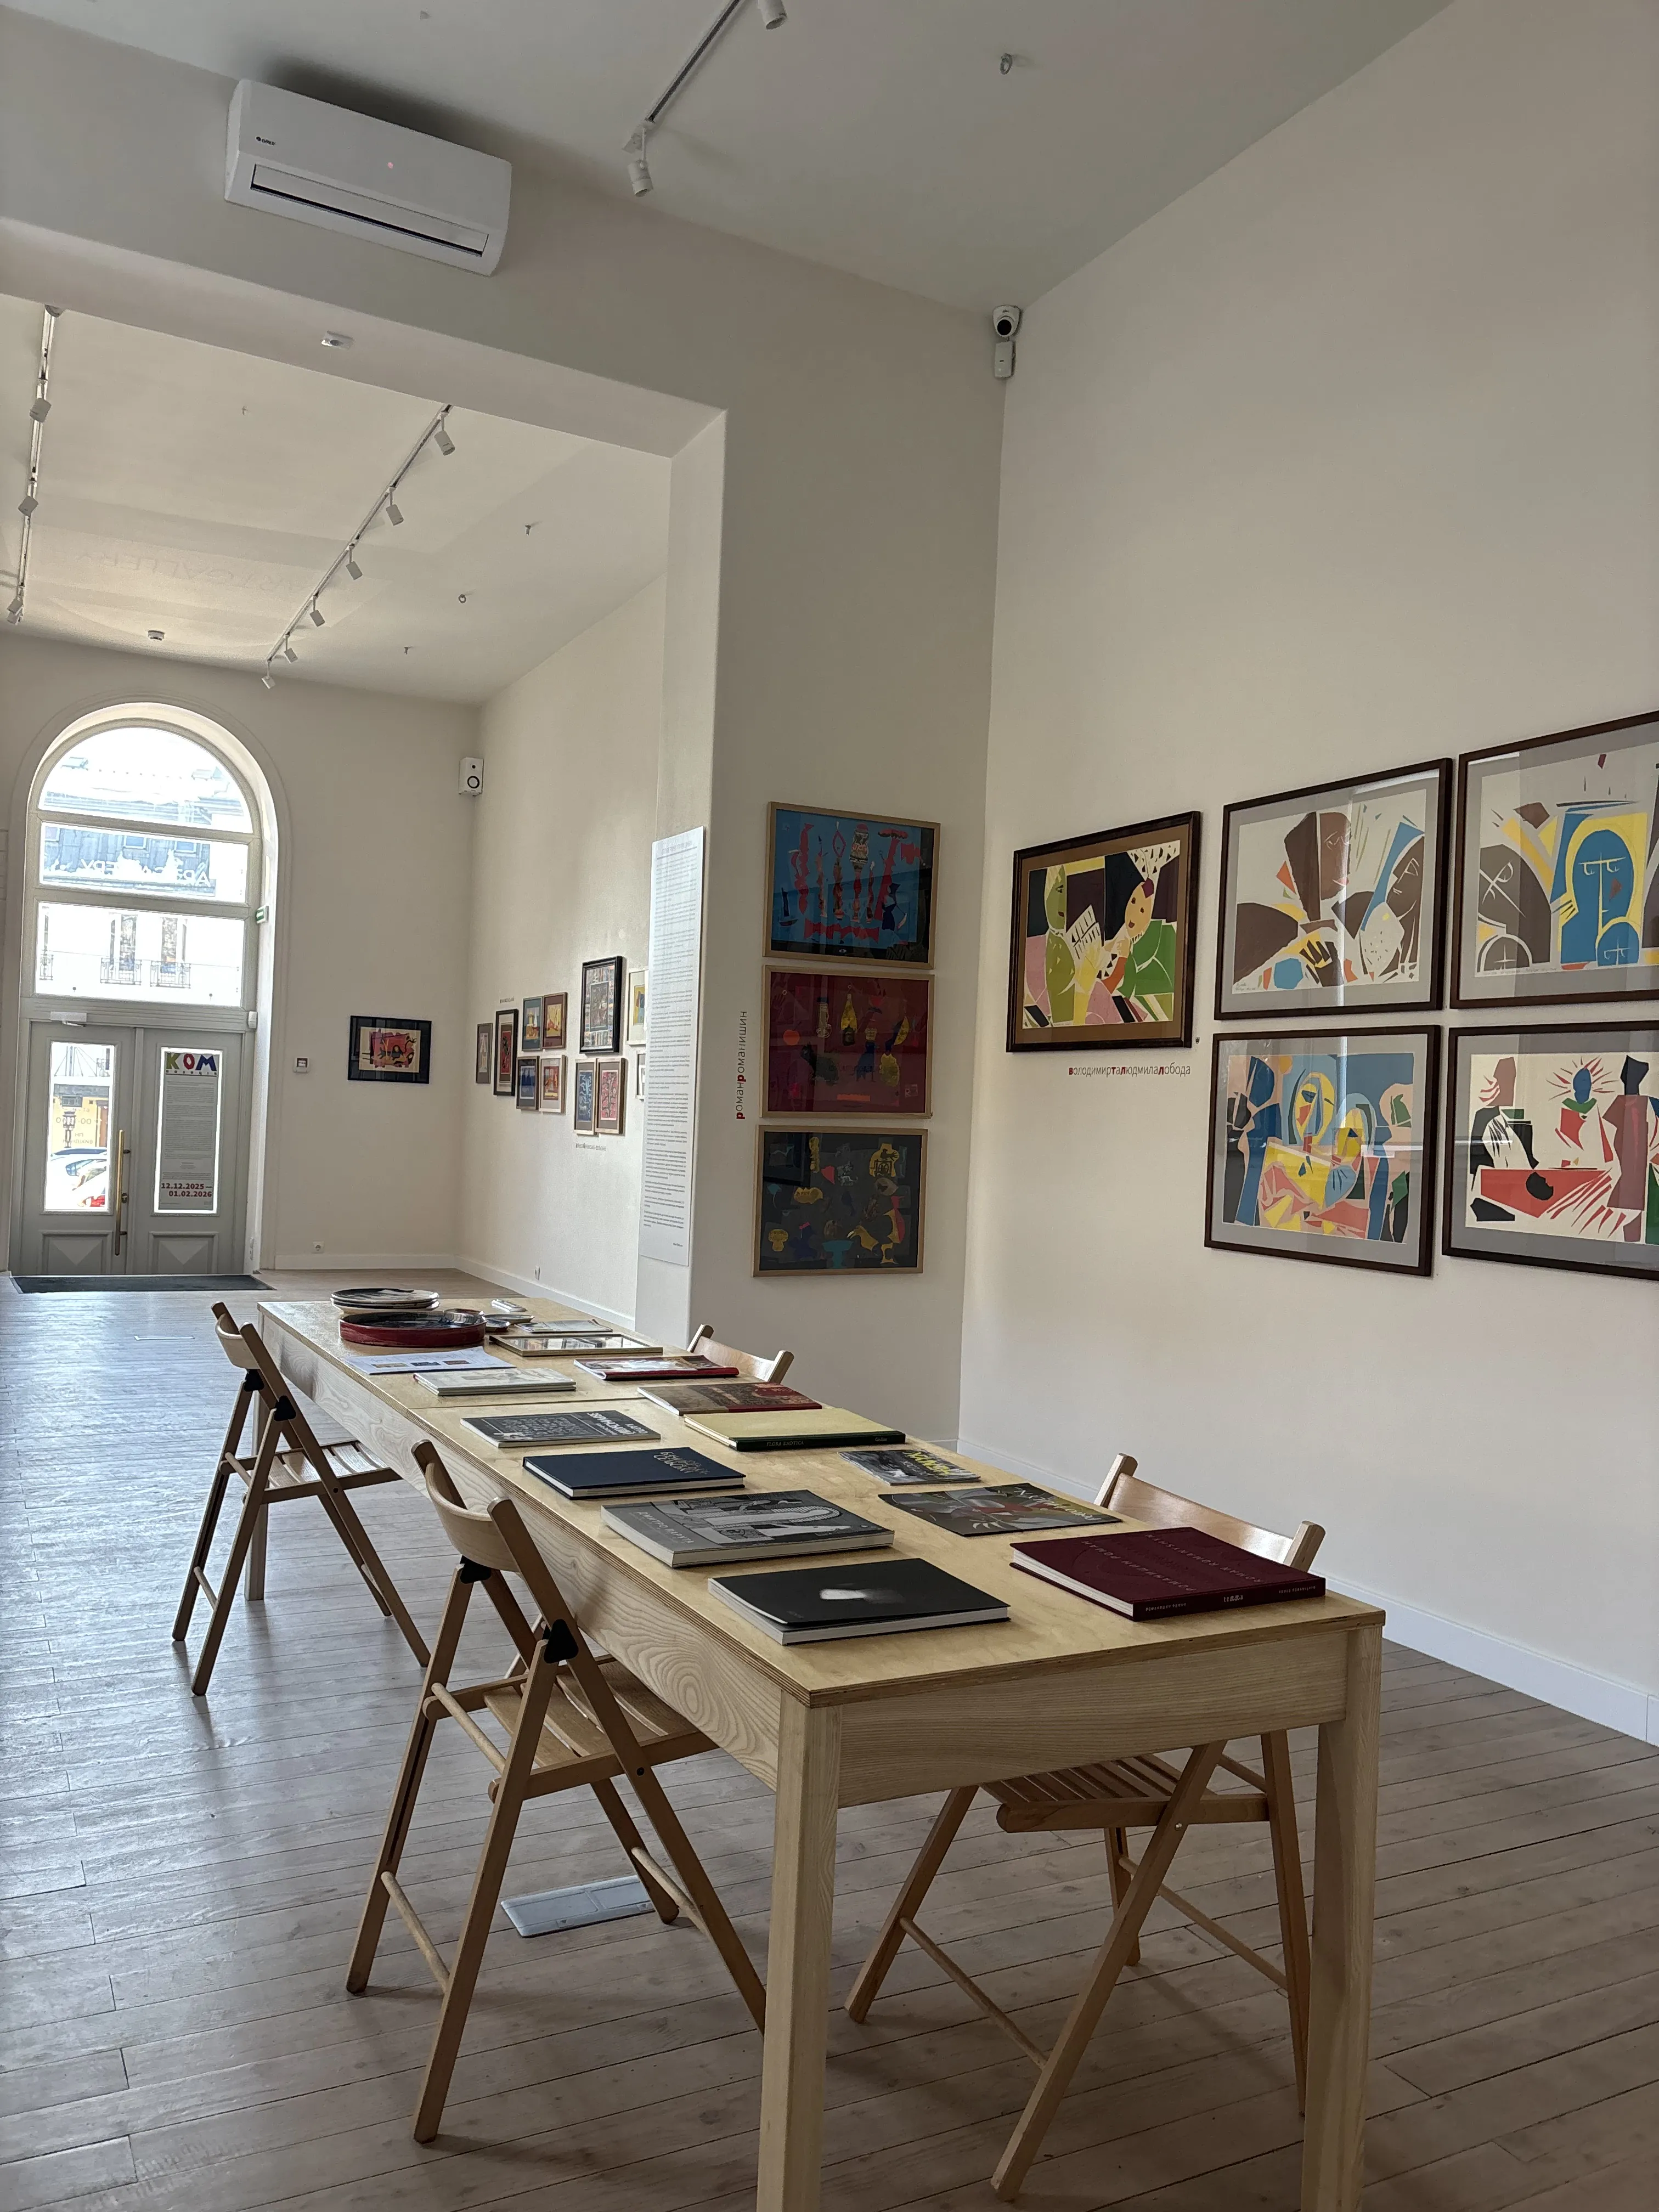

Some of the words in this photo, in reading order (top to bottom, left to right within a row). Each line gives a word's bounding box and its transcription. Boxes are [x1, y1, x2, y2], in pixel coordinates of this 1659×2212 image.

[166, 1053, 217, 1071] КОМ
[736, 1011, 747, 1119] романроманишин
[1068, 1062, 1190, 1077] володимирталюдмилалобода
[1221, 1565, 1262, 1583] ROMAN
